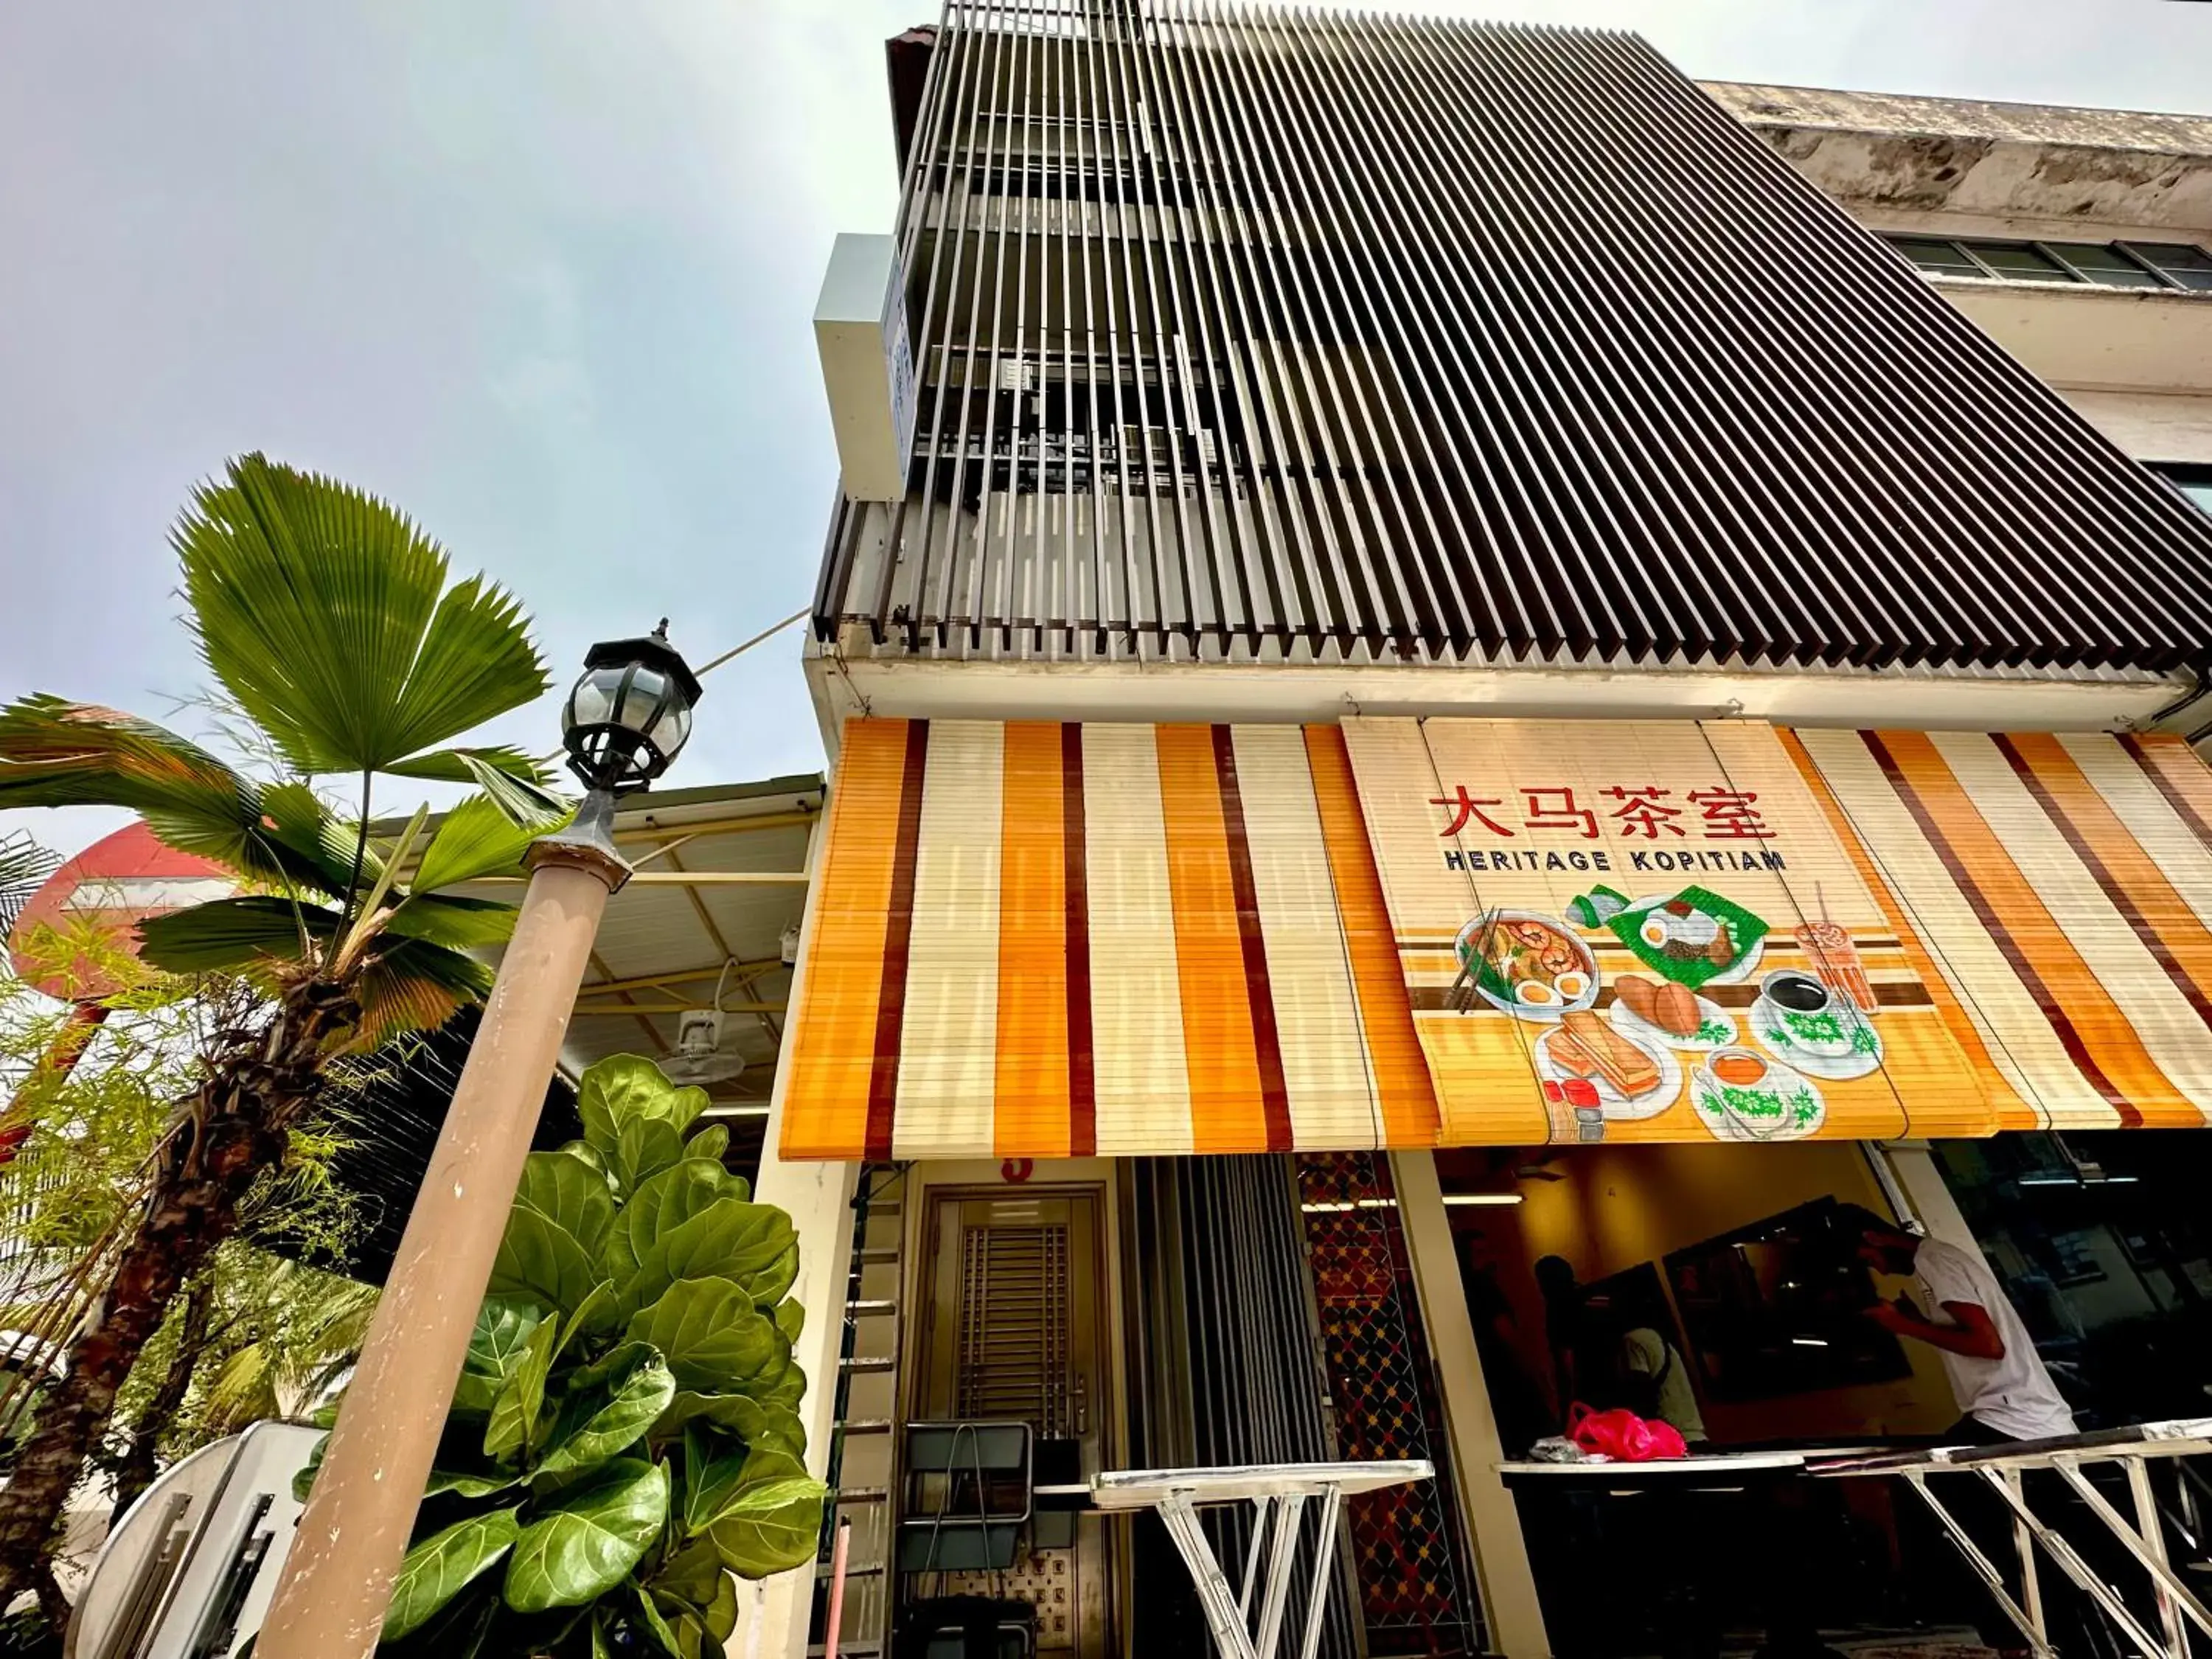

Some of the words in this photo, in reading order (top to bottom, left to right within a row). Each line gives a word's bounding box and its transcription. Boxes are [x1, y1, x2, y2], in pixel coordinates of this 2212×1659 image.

[1429, 785, 1778, 839] 大马茶室
[1444, 850, 1611, 871] HERITAGE
[1630, 850, 1787, 871] KOPITIAM
